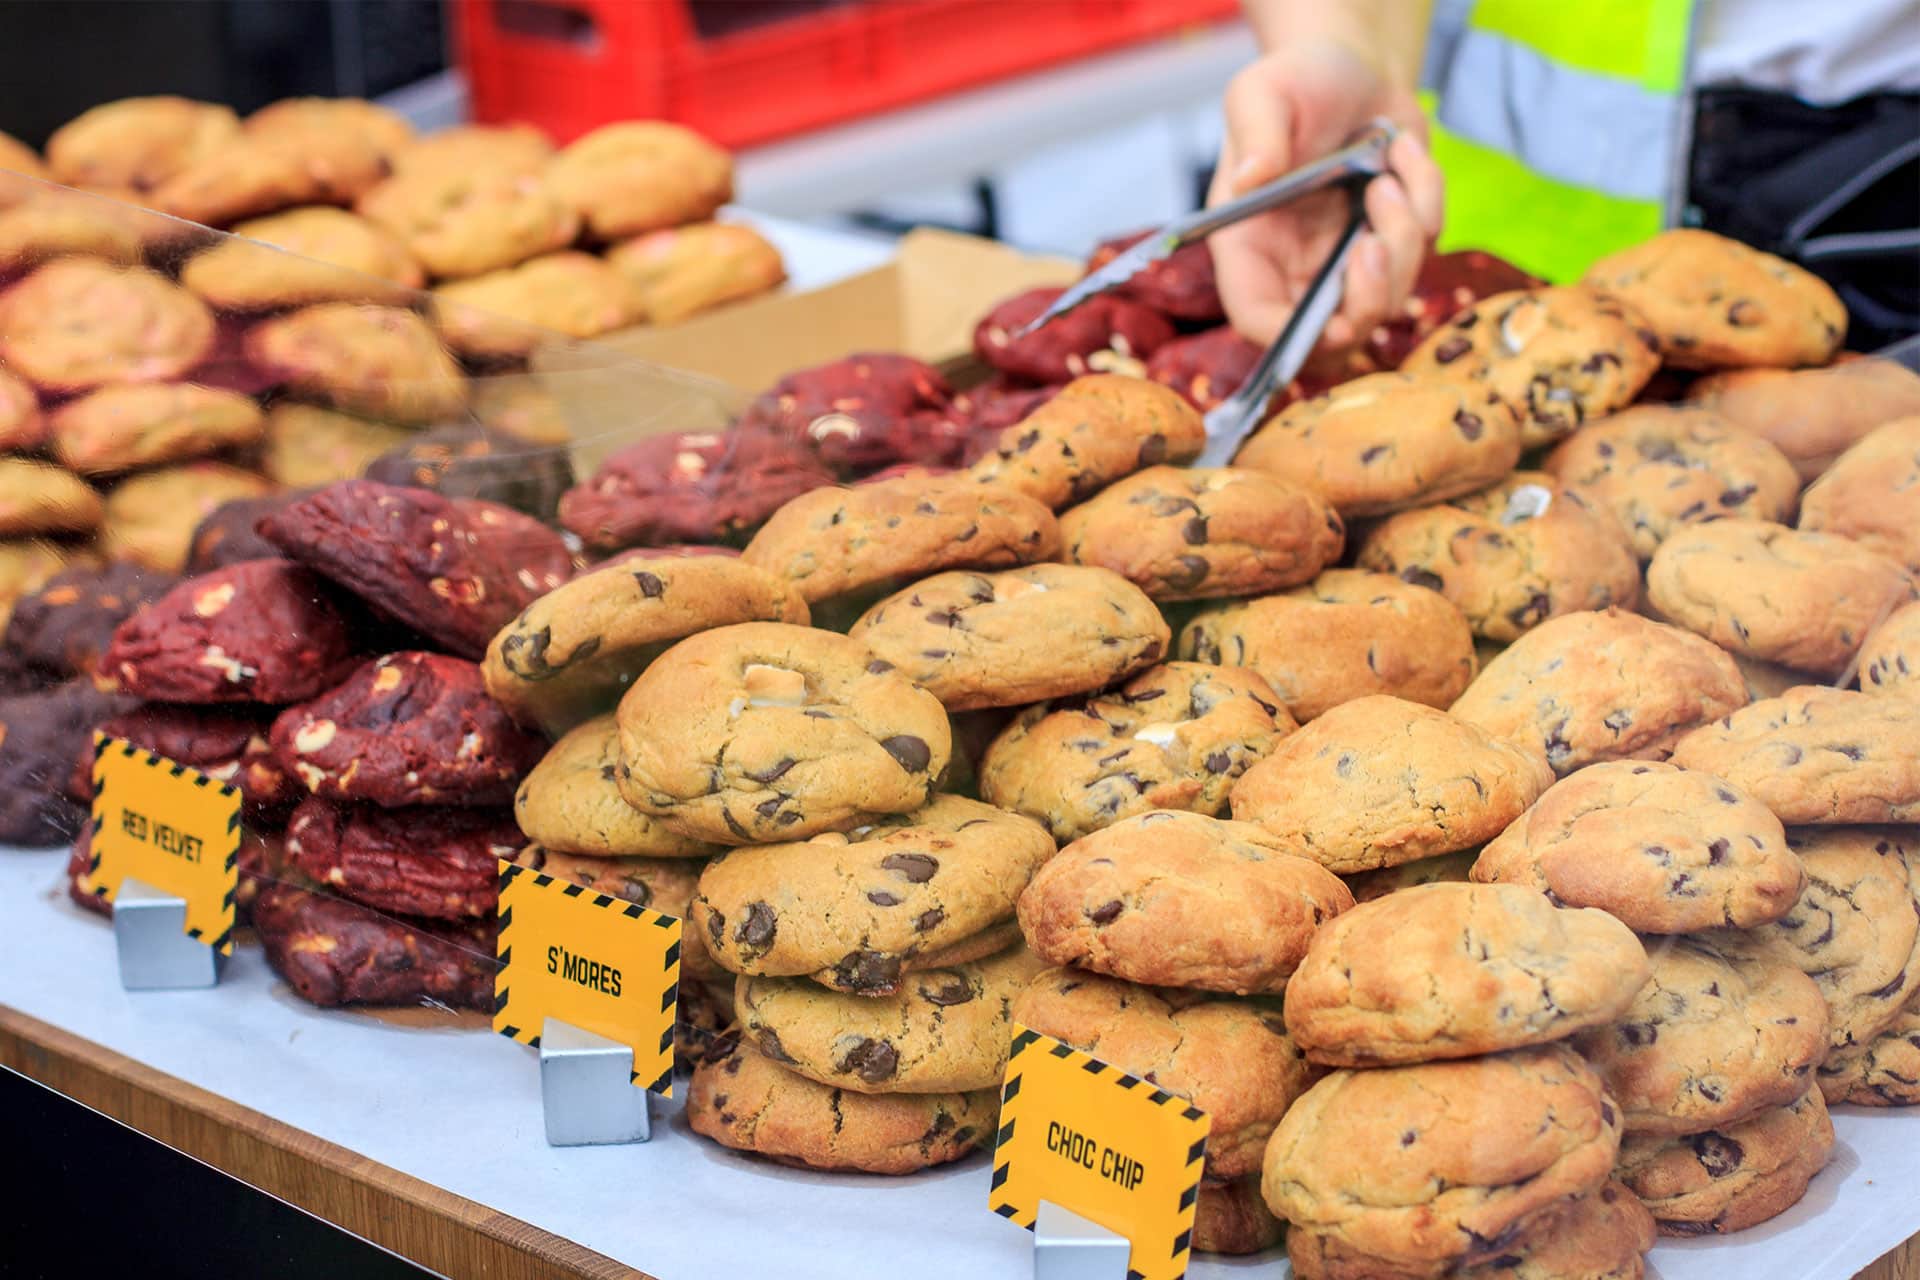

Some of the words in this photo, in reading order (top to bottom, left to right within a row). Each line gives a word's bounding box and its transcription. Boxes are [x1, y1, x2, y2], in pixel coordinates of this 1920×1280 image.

[122, 808, 147, 842] RED
[152, 820, 203, 864] VELVET
[547, 945, 622, 998] S'MORES
[1047, 1120, 1097, 1170] CHOC
[1100, 1147, 1144, 1191] CHIP
